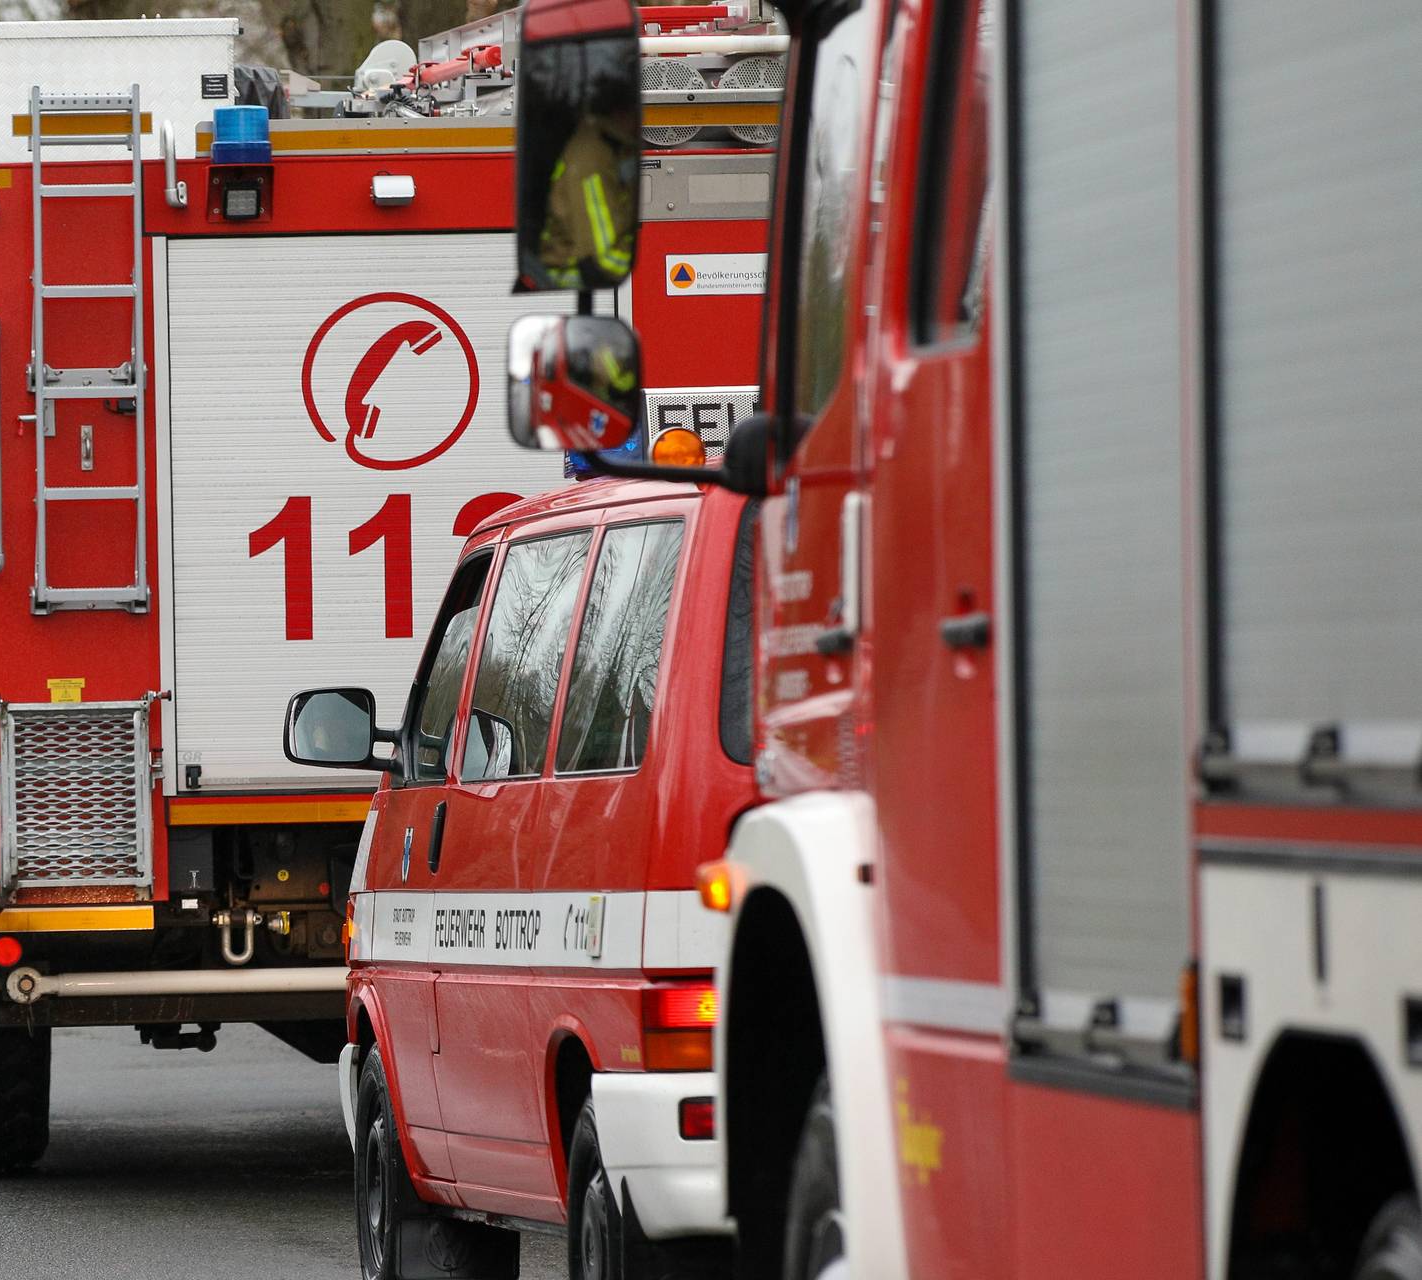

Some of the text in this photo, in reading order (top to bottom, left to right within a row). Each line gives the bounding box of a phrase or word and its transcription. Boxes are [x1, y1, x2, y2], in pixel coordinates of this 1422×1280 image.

[249, 492, 526, 640] 11
[435, 909, 486, 948] FEUERWEHR
[495, 909, 542, 950] BOTTROP
